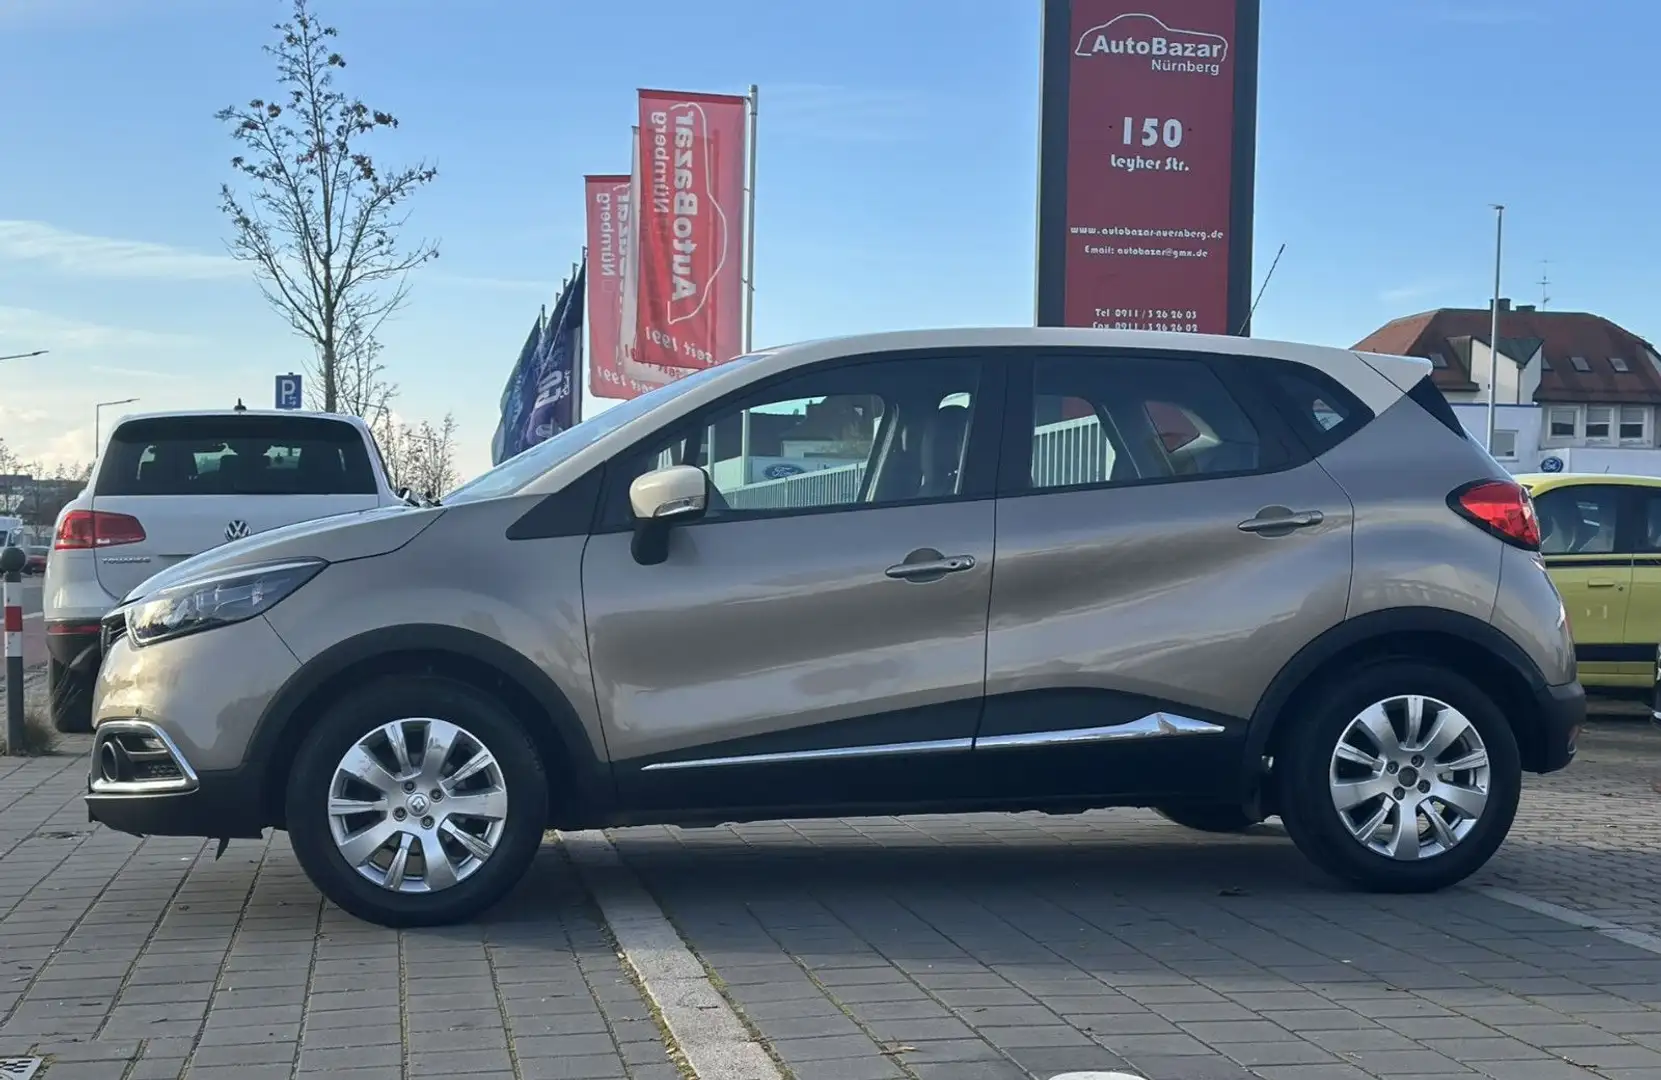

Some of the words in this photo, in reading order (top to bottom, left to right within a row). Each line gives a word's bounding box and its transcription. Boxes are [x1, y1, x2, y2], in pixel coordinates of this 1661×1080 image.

[1092, 35, 1222, 58] AutoBazar
[1151, 59, 1219, 76] Nürnberg
[1123, 116, 1182, 148] 150
[1111, 154, 1161, 172] Leyher
[1165, 156, 1190, 171] Str.
[1070, 226, 1224, 242] www.autobazar-nuernberg.de
[1084, 245, 1115, 254] Email:
[1115, 309, 1138, 317] 0911
[1156, 310, 1168, 318] 26
[1171, 310, 1183, 319] 26
[281, 379, 296, 405] P
